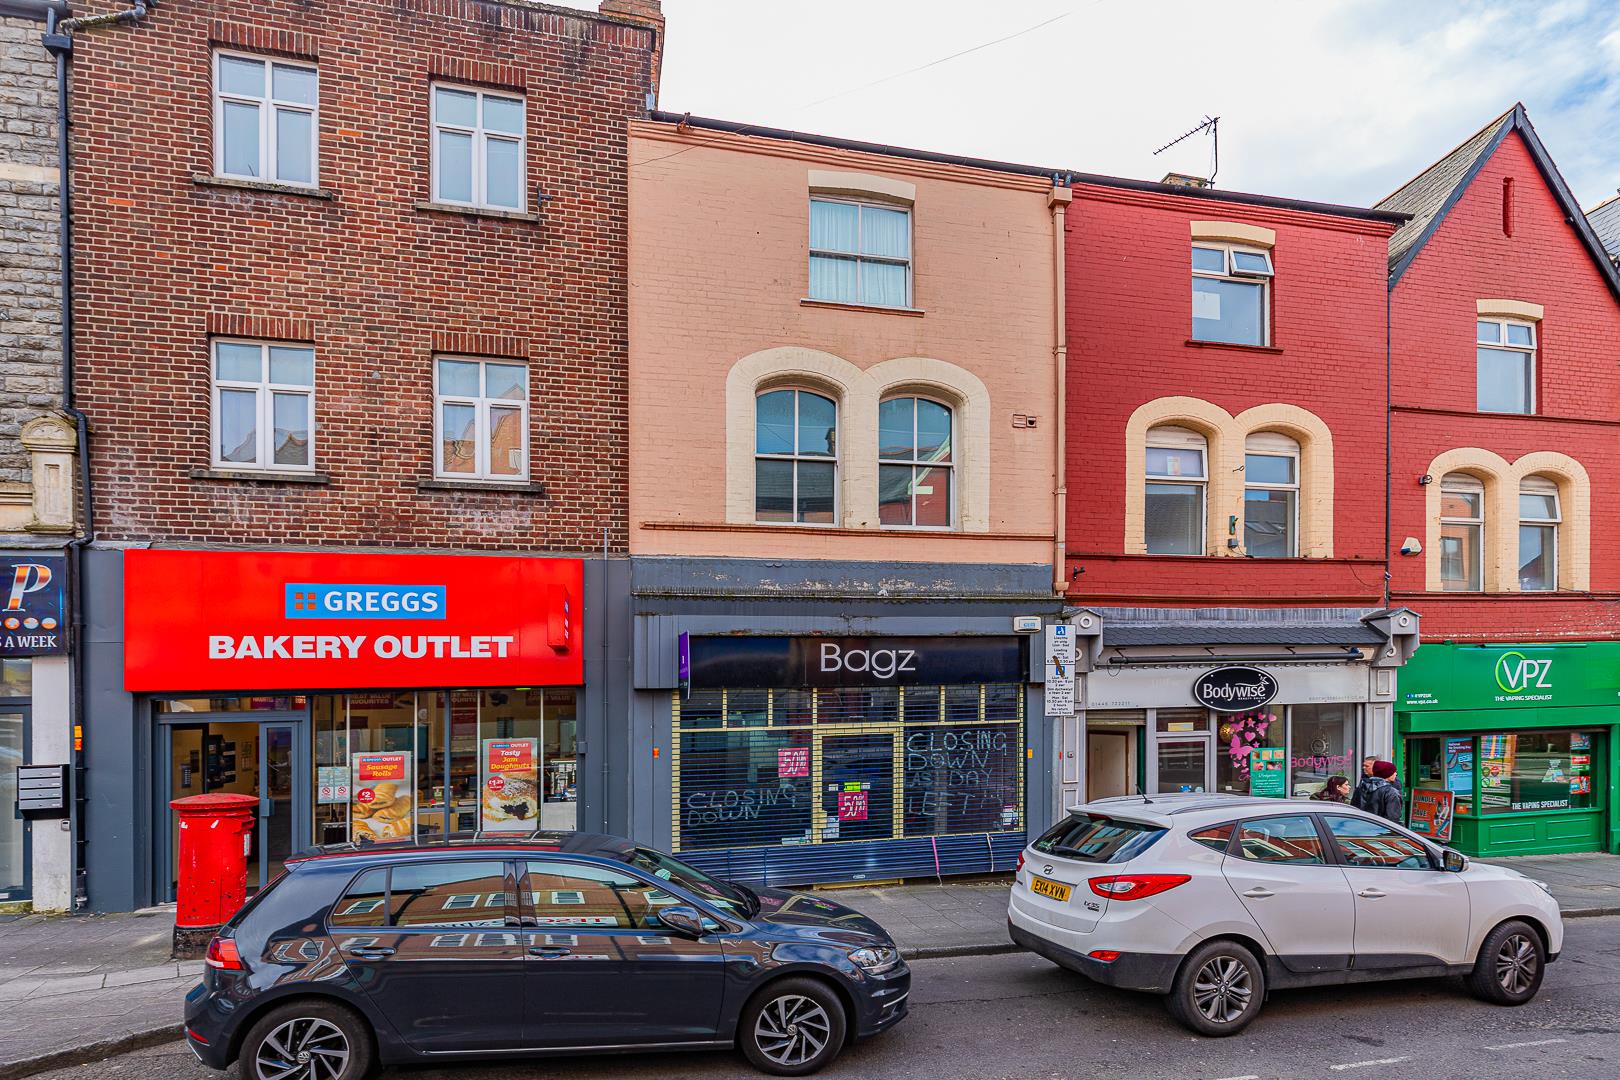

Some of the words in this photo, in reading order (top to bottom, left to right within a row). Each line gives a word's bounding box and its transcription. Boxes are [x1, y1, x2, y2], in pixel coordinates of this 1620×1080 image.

[2, 564, 52, 612] P
[323, 591, 439, 612] GREGGS
[4, 635, 15, 648] A
[17, 635, 58, 648] WEEK
[208, 635, 367, 659] BAKERY
[373, 634, 514, 659] OUTLET
[820, 643, 916, 679] Bagz
[1502, 659, 1553, 688] VPZ
[1203, 683, 1266, 701] Bodywise
[907, 730, 1007, 756] CLOSING
[491, 763, 530, 771] Doughnuts
[908, 750, 989, 771] DOWN
[949, 768, 993, 787] DAY
[687, 784, 797, 808] CLOSING
[1511, 802, 1522, 810] THE
[1522, 801, 1540, 809] VAPING
[1541, 799, 1568, 808] SPECIALIST
[688, 805, 760, 827] DOWN
[1034, 879, 1049, 895] EX14
[1049, 883, 1066, 899] XVN
